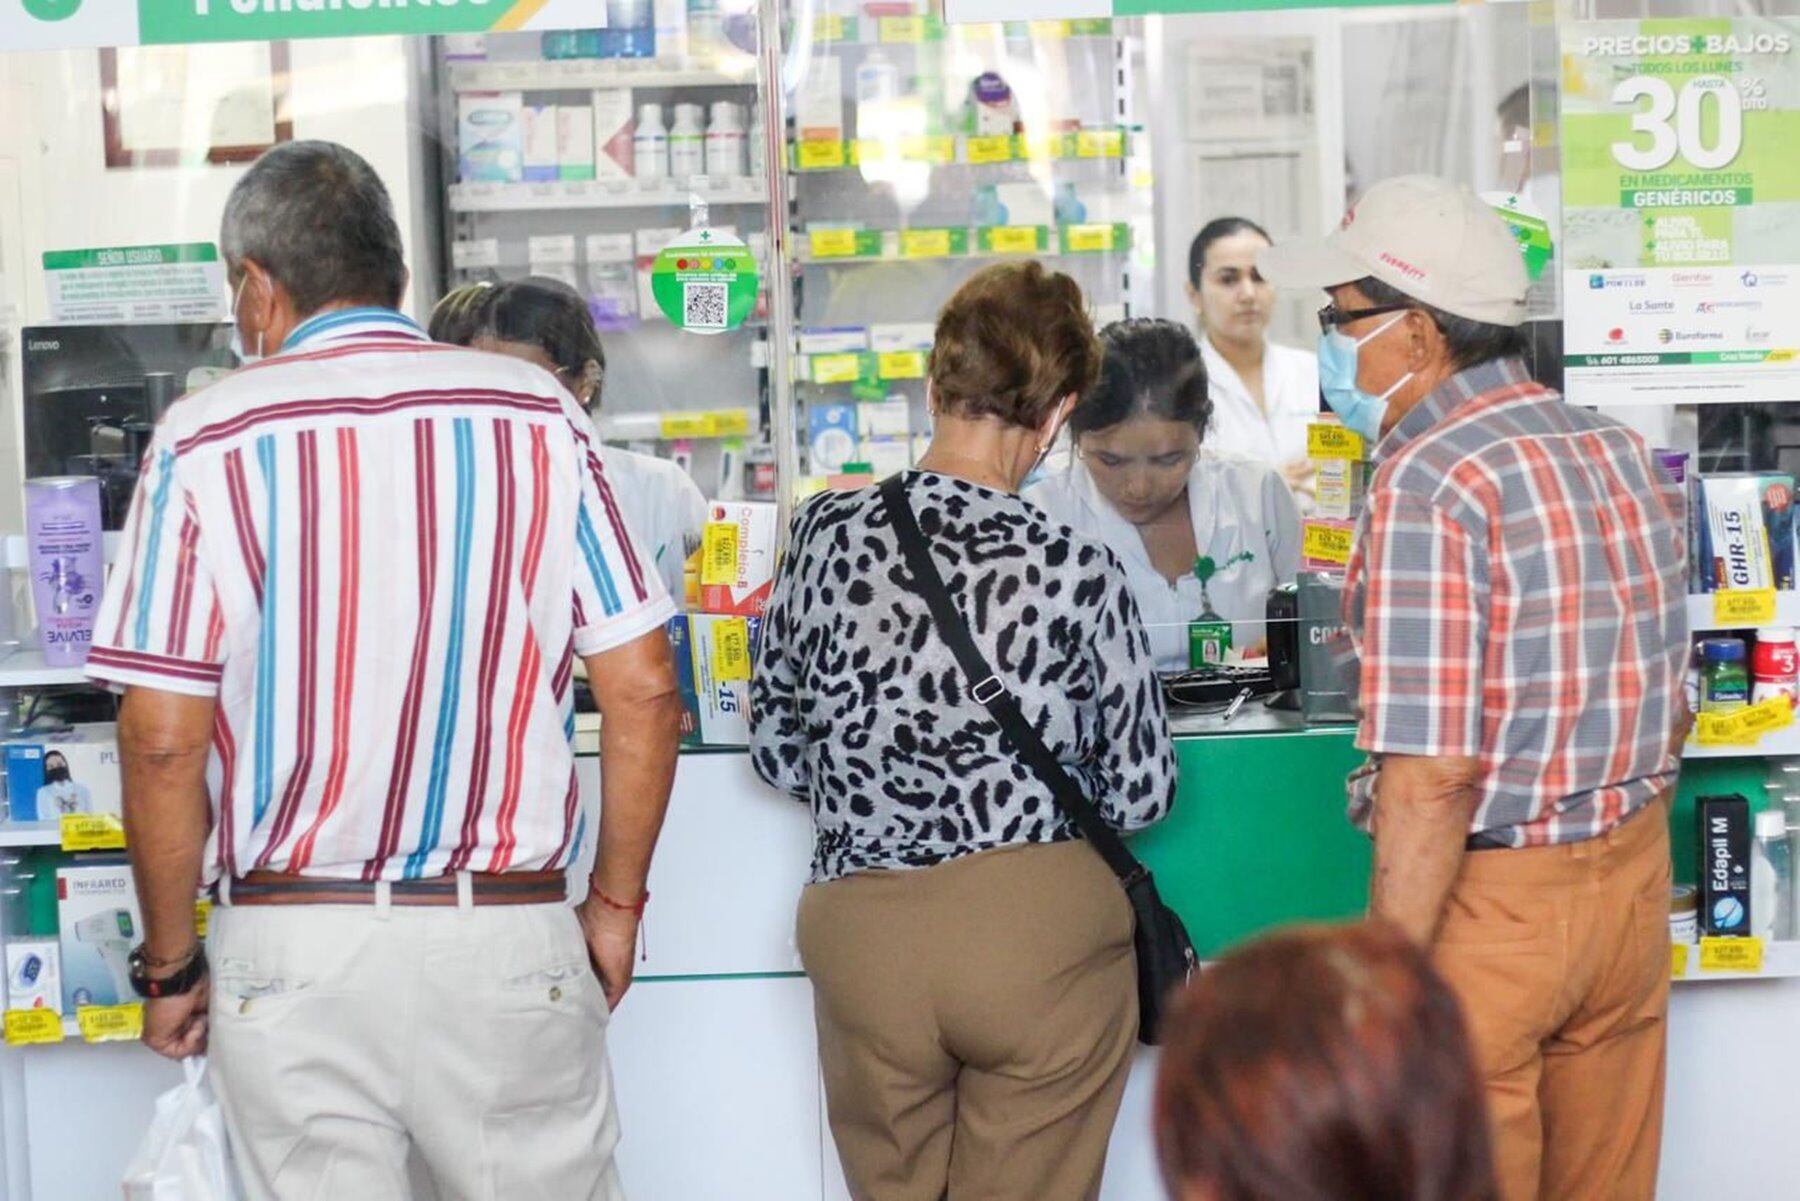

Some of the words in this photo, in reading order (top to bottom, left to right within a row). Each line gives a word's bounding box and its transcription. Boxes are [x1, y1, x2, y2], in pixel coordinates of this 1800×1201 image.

[1609, 74, 1742, 171] 30
[1619, 175, 1639, 188] EN
[1642, 172, 1753, 187] MEDICAMENTOS
[1633, 188, 1736, 207] GENÉRICOS
[28, 340, 60, 351] Lenovo
[1724, 511, 1750, 586] GHR-15
[47, 629, 93, 643] ELVIVE
[1711, 817, 1728, 834] M
[1712, 838, 1732, 892] Edapil
[73, 878, 127, 889] INFRARED
